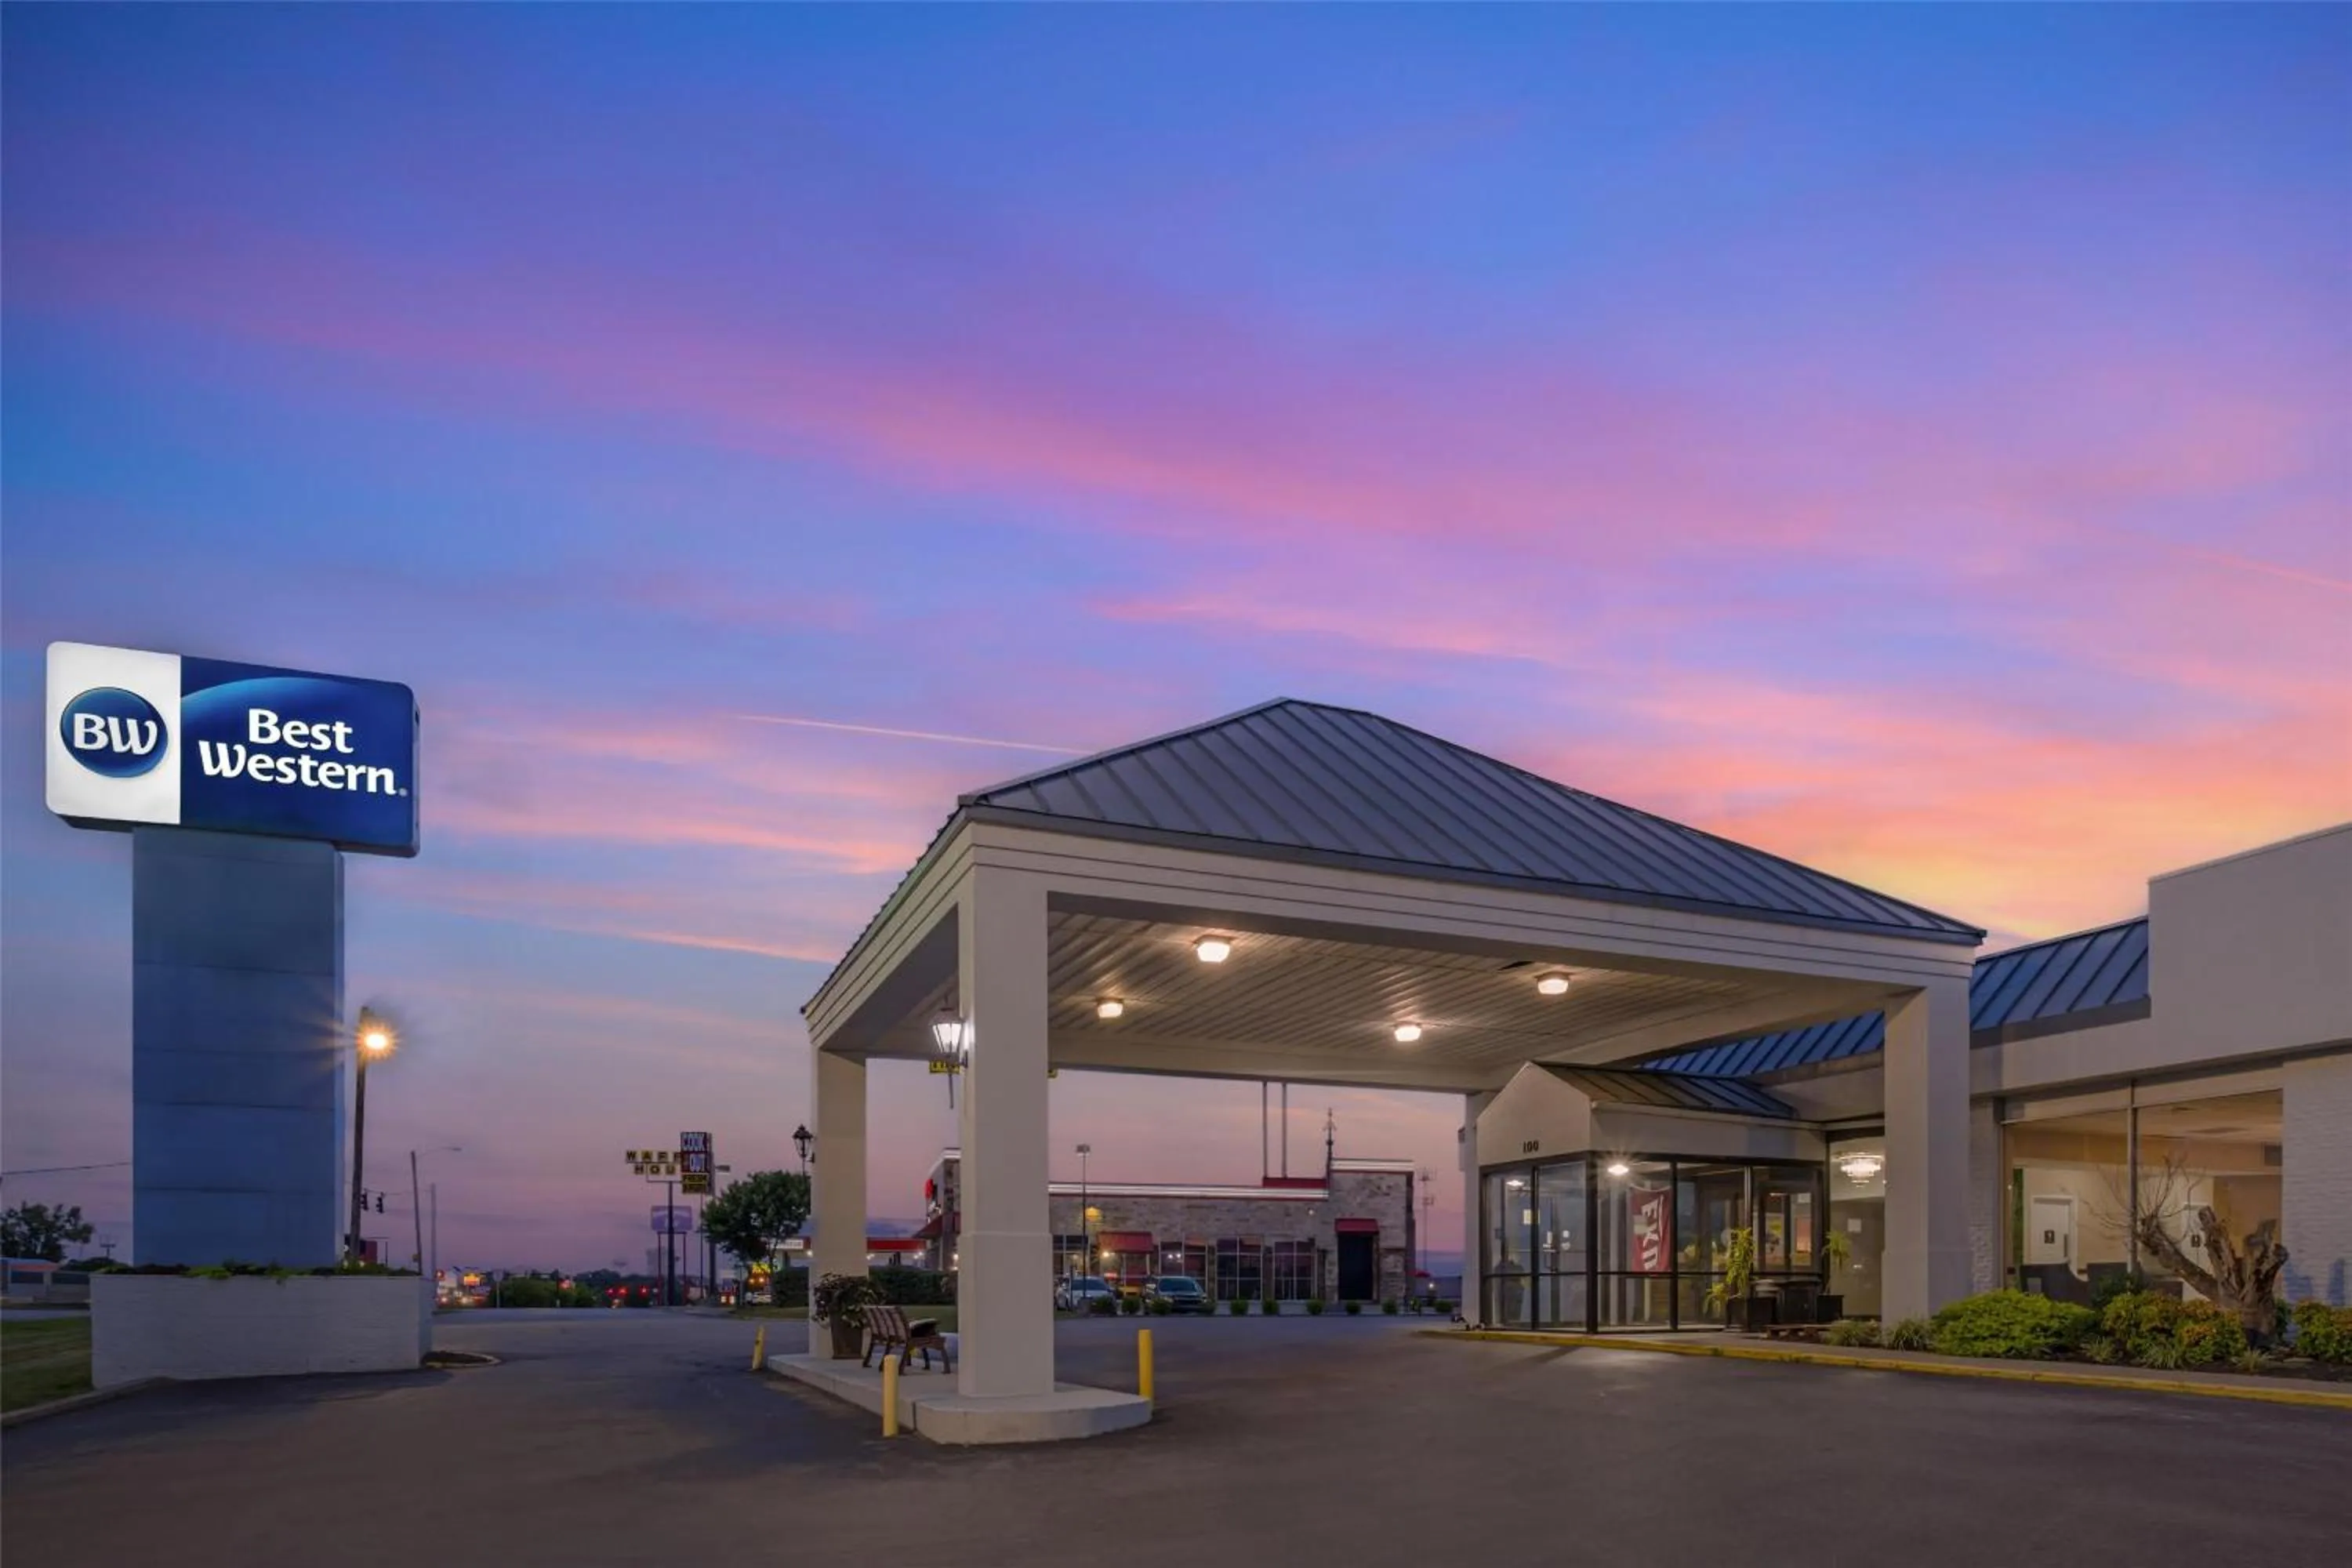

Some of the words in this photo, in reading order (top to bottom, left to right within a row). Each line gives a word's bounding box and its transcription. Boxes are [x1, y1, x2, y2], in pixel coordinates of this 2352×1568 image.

[73, 713, 158, 756] BW
[248, 708, 354, 754] Best
[1523, 1140, 1539, 1153] 100
[626, 1151, 681, 1162] WAFF
[634, 1164, 676, 1174] HOU
